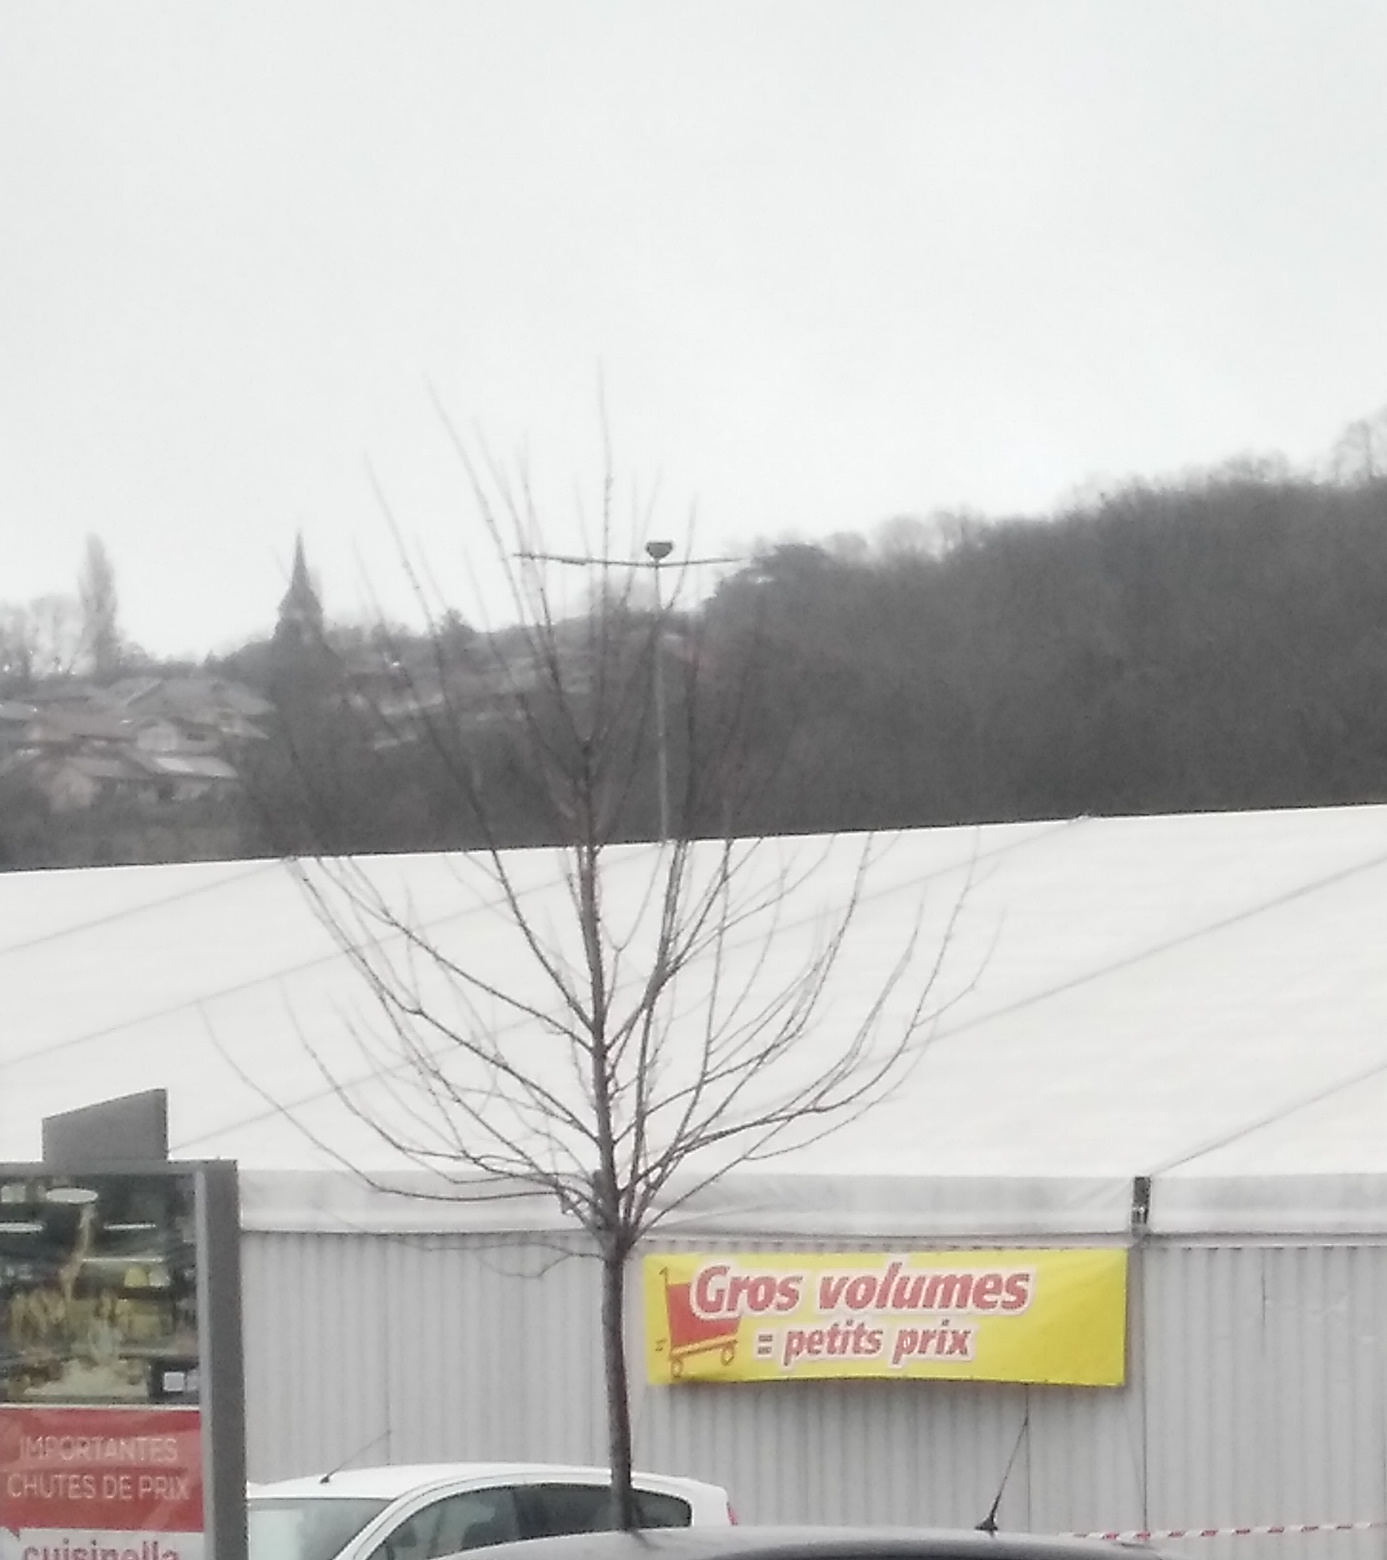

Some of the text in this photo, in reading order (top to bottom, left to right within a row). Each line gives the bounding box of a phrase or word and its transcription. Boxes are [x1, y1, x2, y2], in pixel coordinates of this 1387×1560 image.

[694, 1261, 1030, 1315] Gros volumes
[782, 1320, 883, 1366] petits
[891, 1318, 972, 1365] prix
[19, 1436, 179, 1462] IMPORTANTES
[7, 1473, 189, 1500] CHUTES DE PRIX
